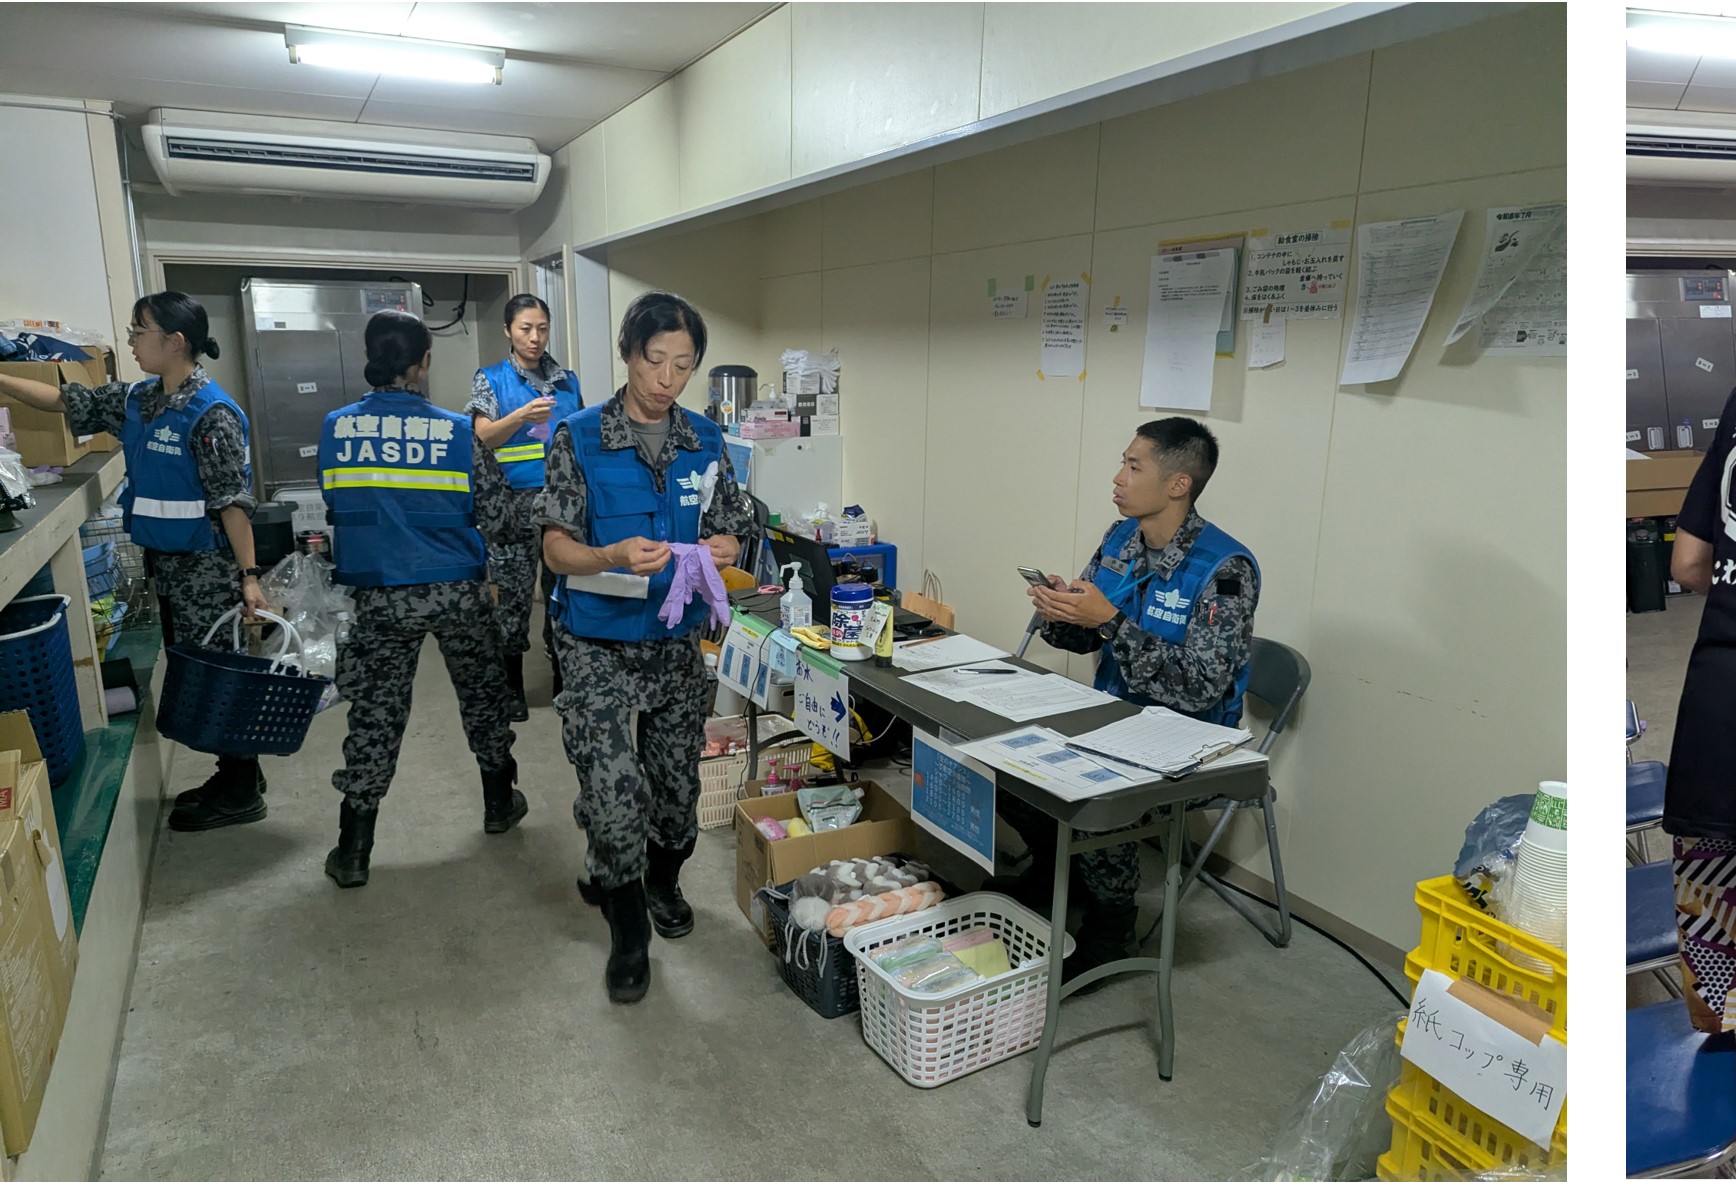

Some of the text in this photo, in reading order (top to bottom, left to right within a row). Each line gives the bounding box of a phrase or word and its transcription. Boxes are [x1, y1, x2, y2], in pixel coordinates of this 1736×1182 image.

[1278, 233, 1319, 244] 給食室の掃除
[334, 414, 454, 441] 航空自衛隊
[336, 440, 448, 465] JASDF
[796, 660, 813, 682] お水
[799, 693, 826, 718] ご自由に
[1412, 998, 1554, 1111] 紙コップ専用
